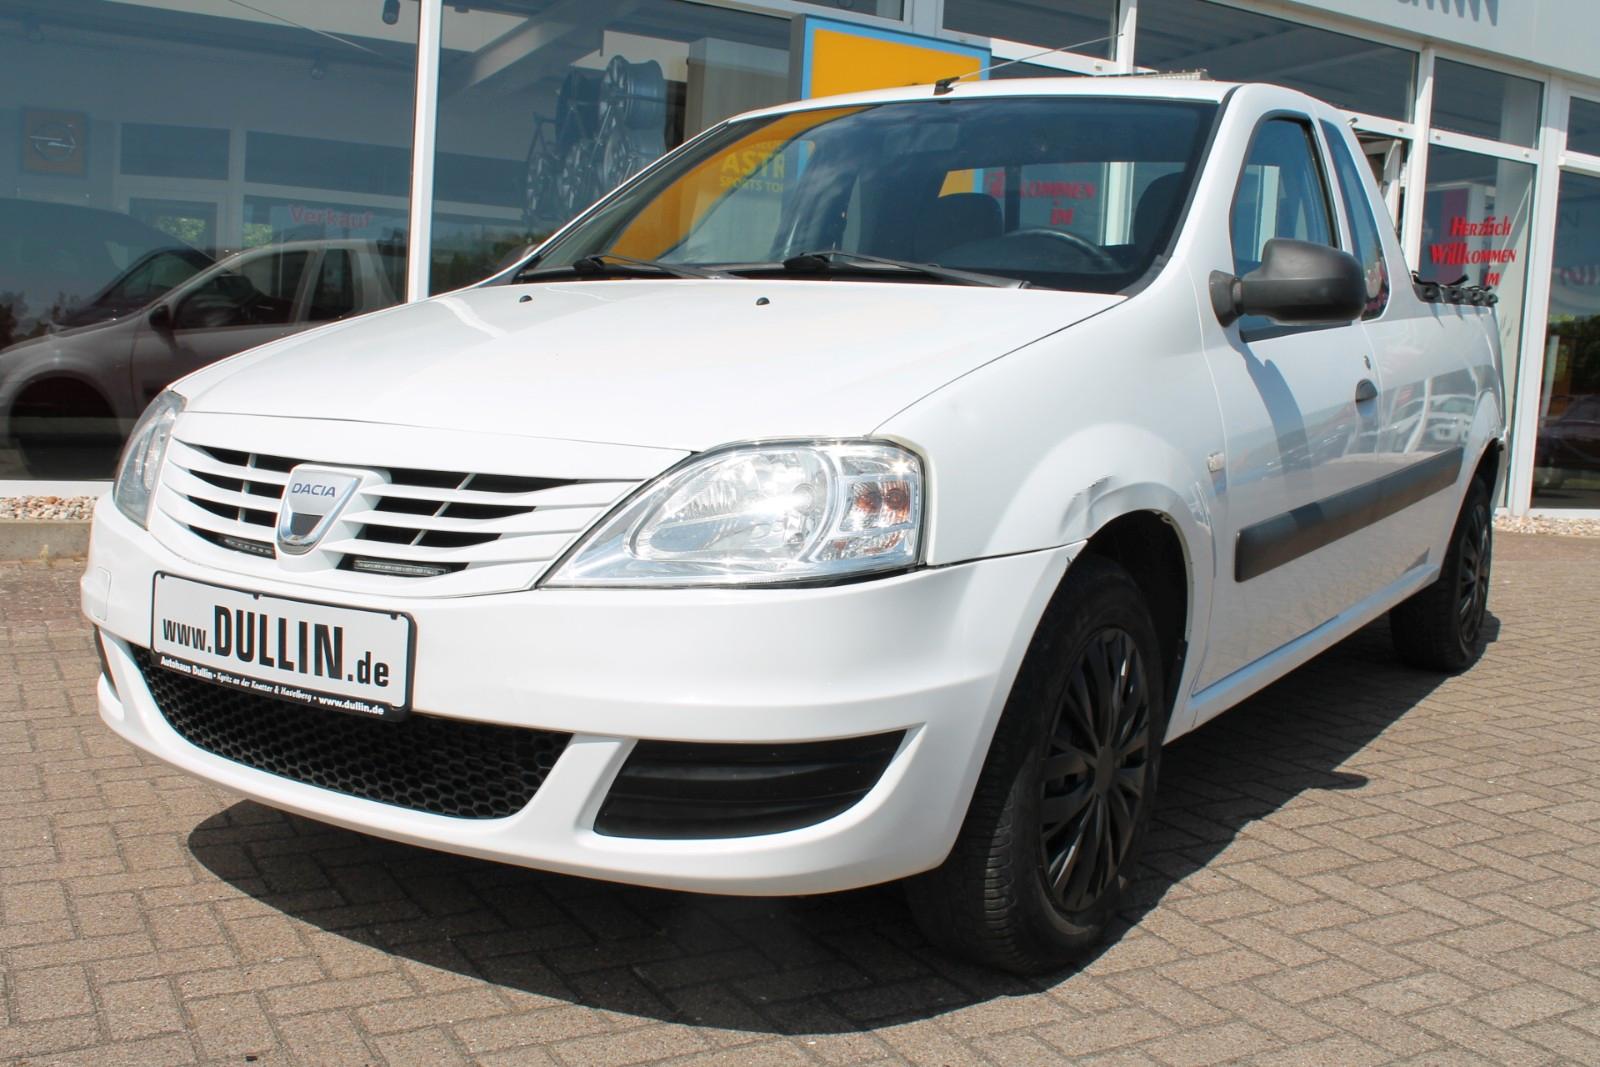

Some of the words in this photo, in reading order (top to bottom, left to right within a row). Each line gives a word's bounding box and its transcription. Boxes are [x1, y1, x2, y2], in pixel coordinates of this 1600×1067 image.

[720, 151, 784, 178] ASTR
[291, 482, 336, 497] DACIA
[163, 605, 389, 688] www.DULLIN.de
[160, 656, 191, 673] Autohaus
[192, 665, 213, 680] Dullin
[319, 696, 384, 715] www.dullin.de
